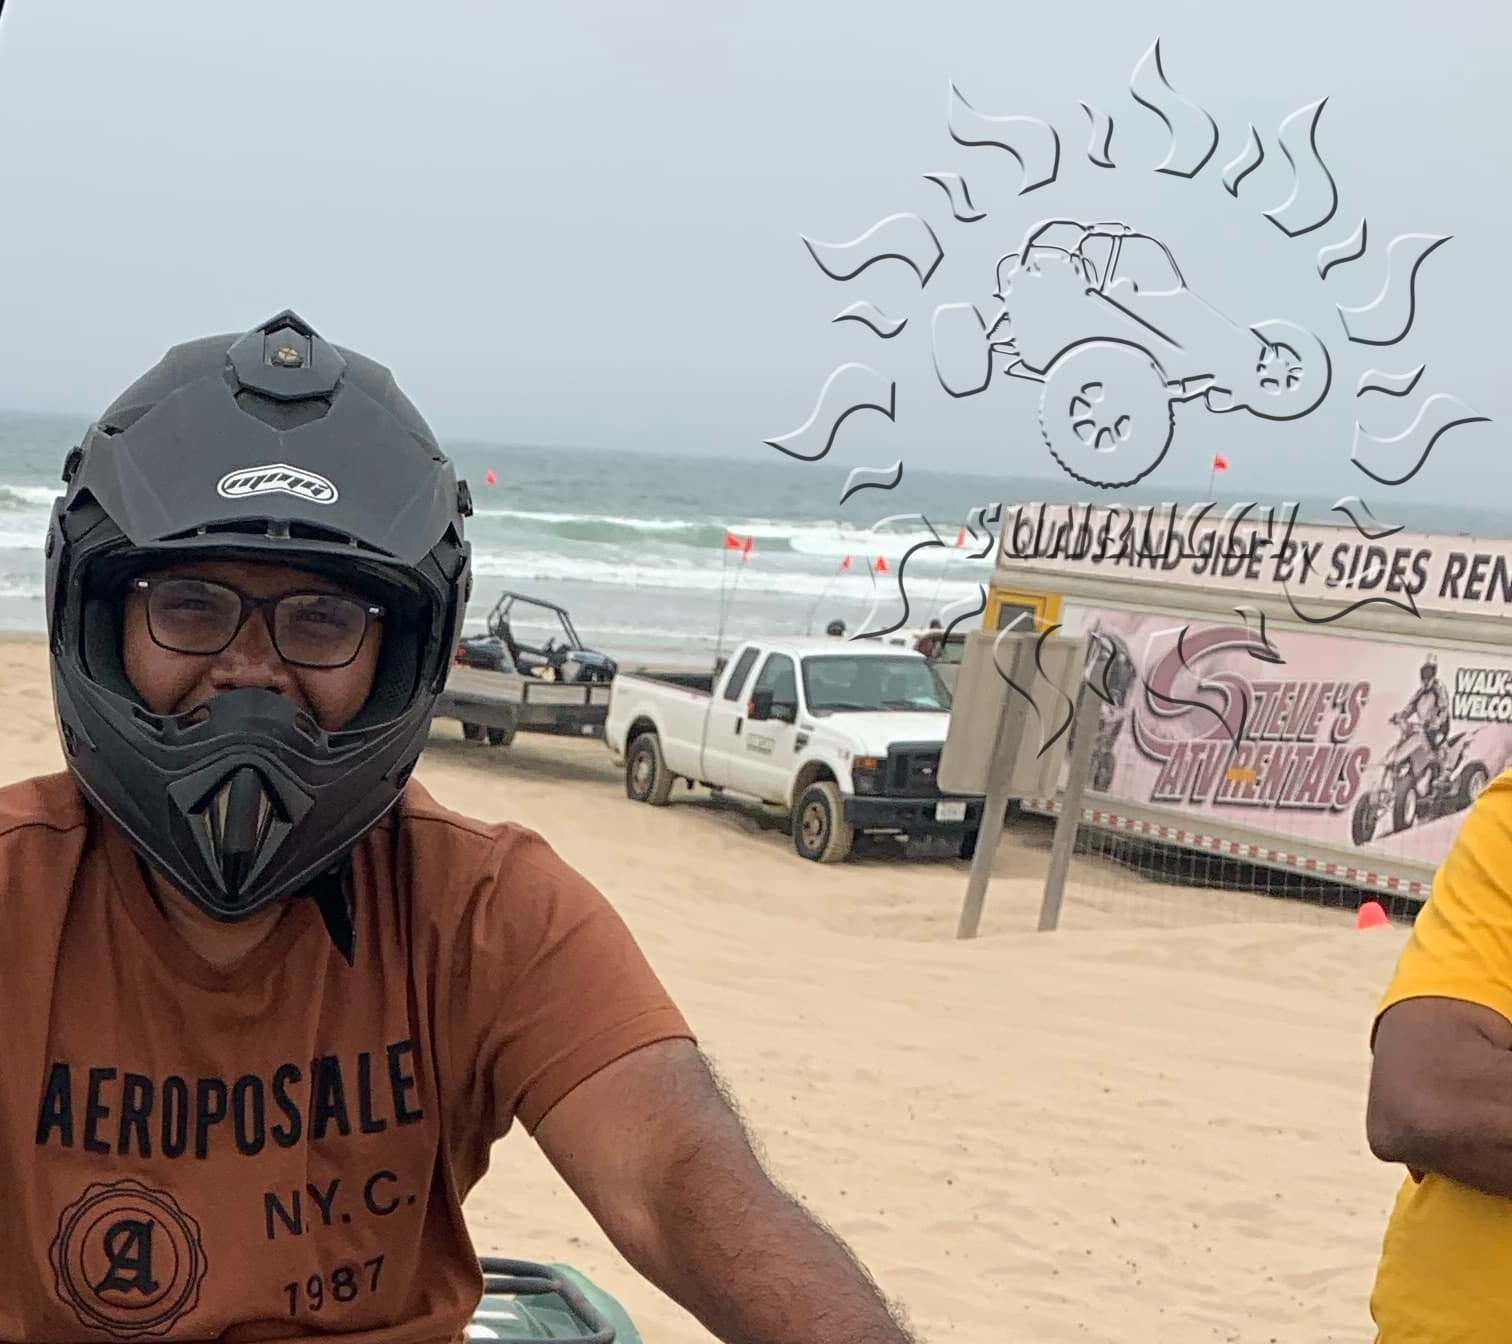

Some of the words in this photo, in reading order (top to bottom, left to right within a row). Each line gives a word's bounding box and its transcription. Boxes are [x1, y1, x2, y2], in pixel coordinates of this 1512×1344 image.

[1114, 527, 1184, 570] AND
[1192, 530, 1265, 580] SIDE
[1273, 540, 1324, 584] BY
[1326, 543, 1432, 595] SIDES
[1150, 742, 1228, 804] ATV
[1213, 742, 1371, 811] RENTALS
[35, 1039, 424, 1160] AEROPOSALE
[284, 1255, 385, 1316] 1987
